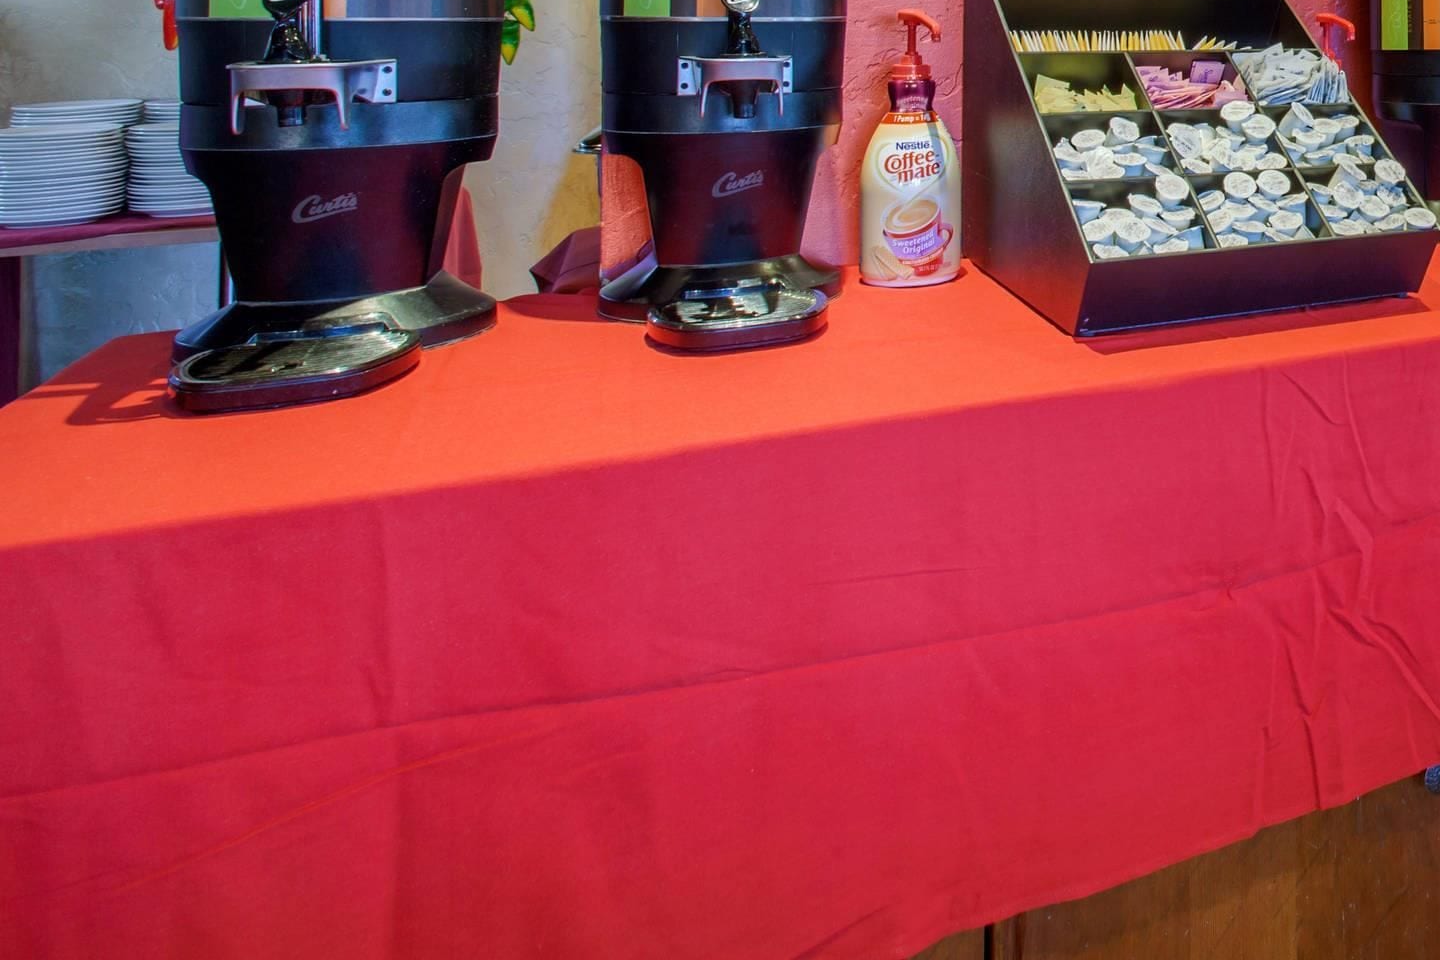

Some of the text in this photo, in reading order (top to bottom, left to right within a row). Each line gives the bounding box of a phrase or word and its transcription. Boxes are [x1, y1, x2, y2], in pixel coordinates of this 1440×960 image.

[897, 162, 940, 183] mate
[291, 192, 359, 224] Curtis
[892, 229, 934, 247] Sweetened
[903, 237, 935, 254] Original
